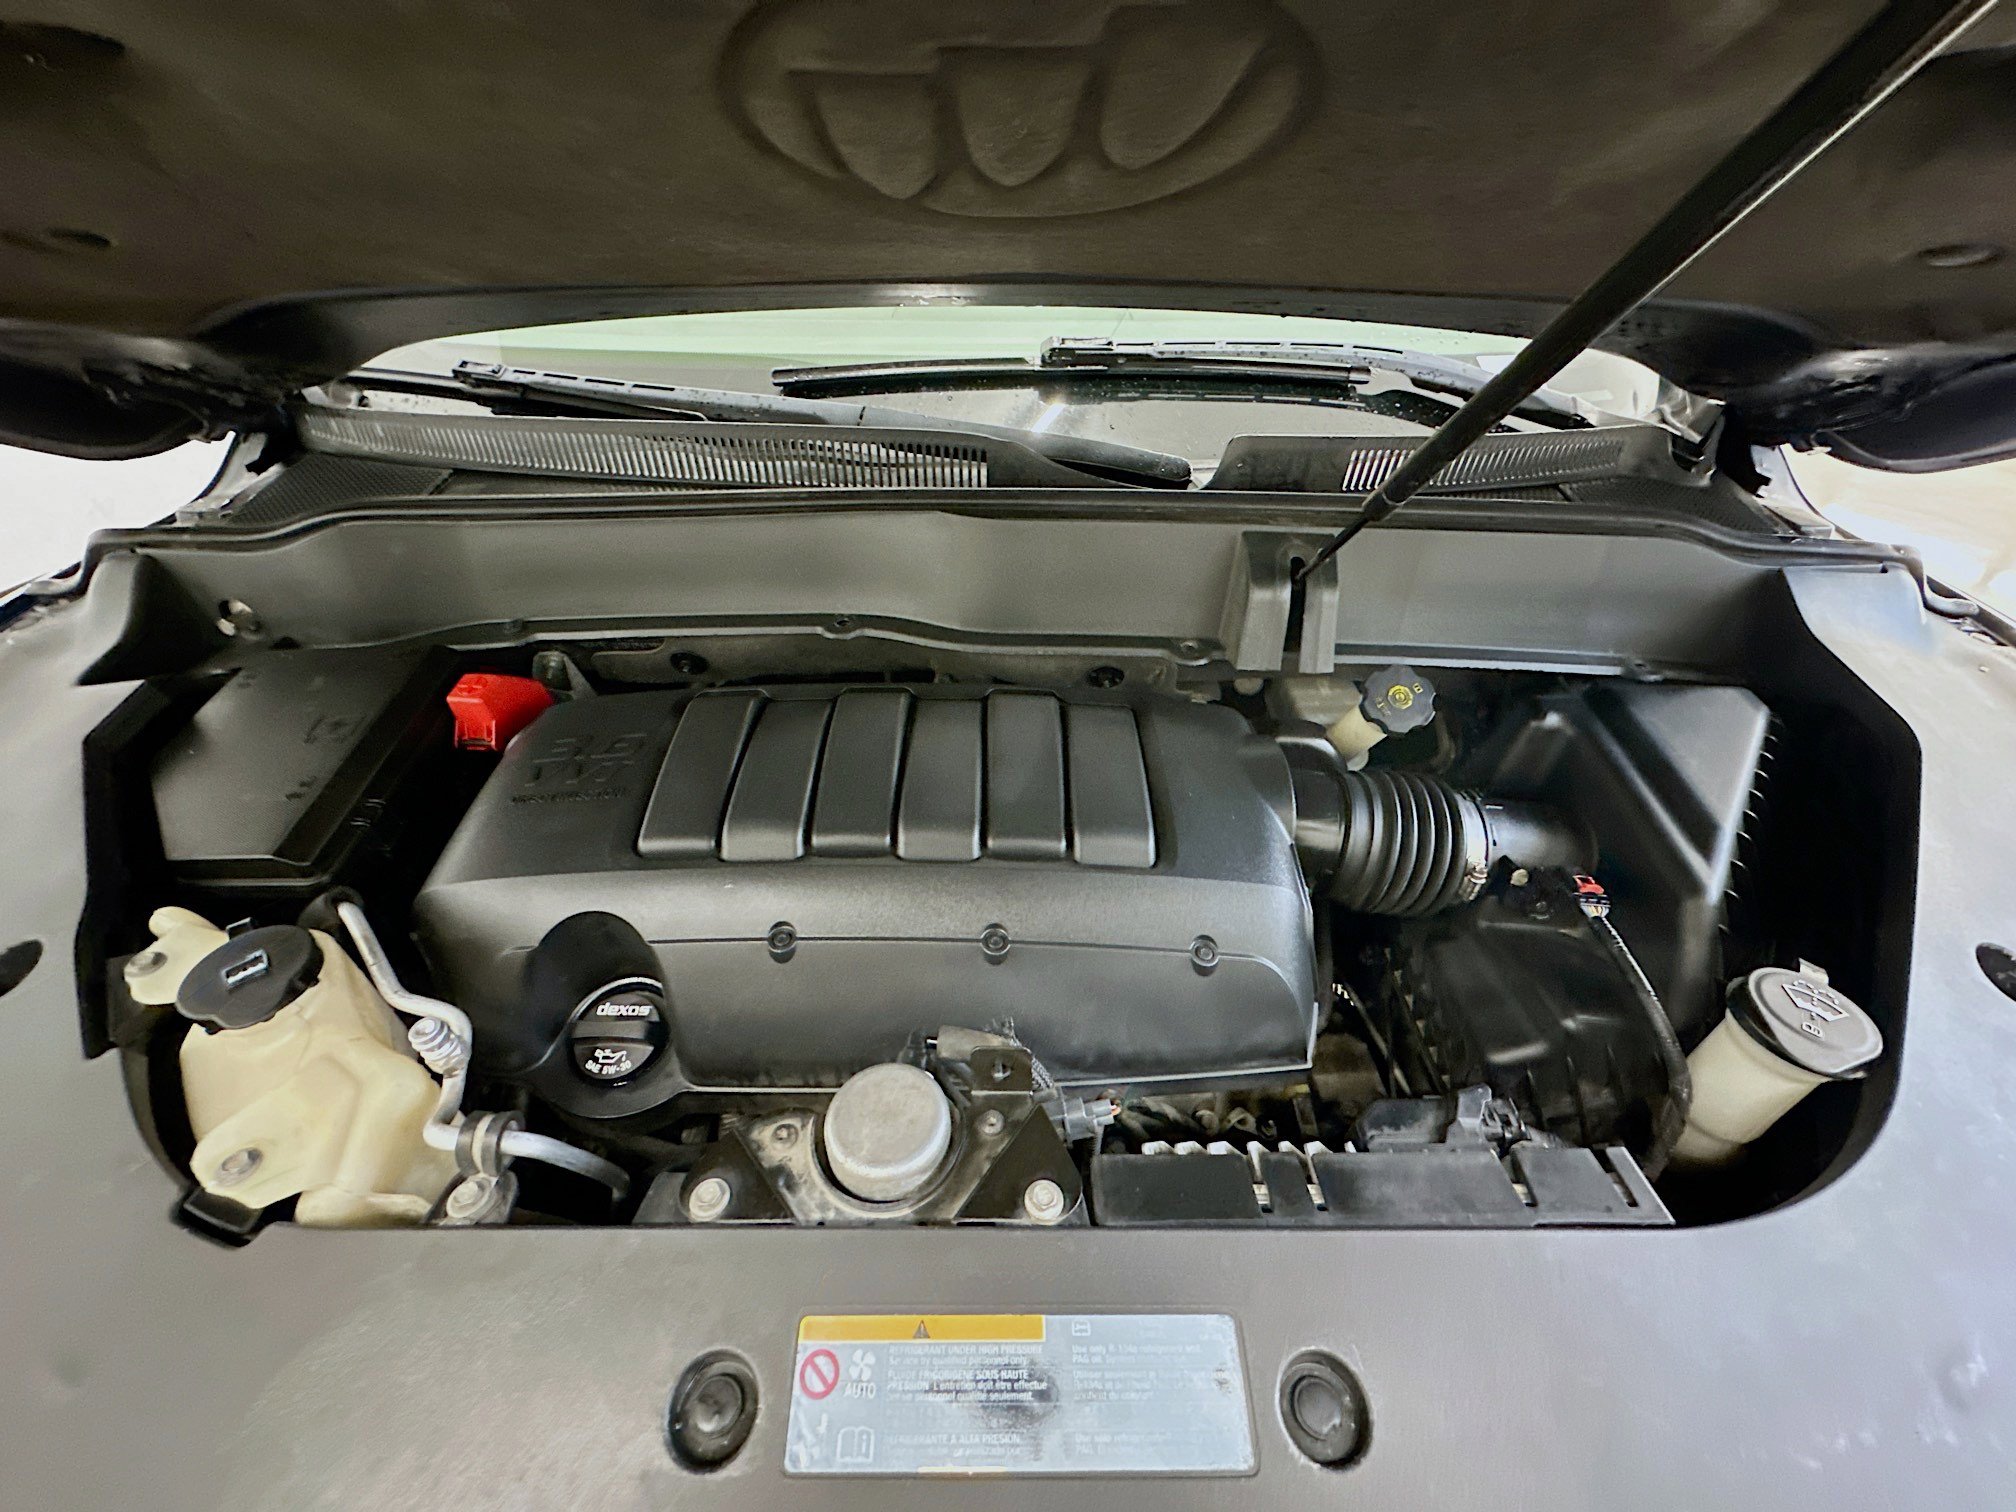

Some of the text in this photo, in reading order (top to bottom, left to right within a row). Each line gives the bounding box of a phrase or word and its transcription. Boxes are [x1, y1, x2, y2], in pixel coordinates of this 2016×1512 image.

[596, 1001, 654, 1017] dexos
[585, 1059, 632, 1075] SAE 5W-30
[976, 1369, 999, 1380] SOUS
[1001, 1369, 1029, 1380] HAUTE
[844, 1382, 876, 1399] AUTO
